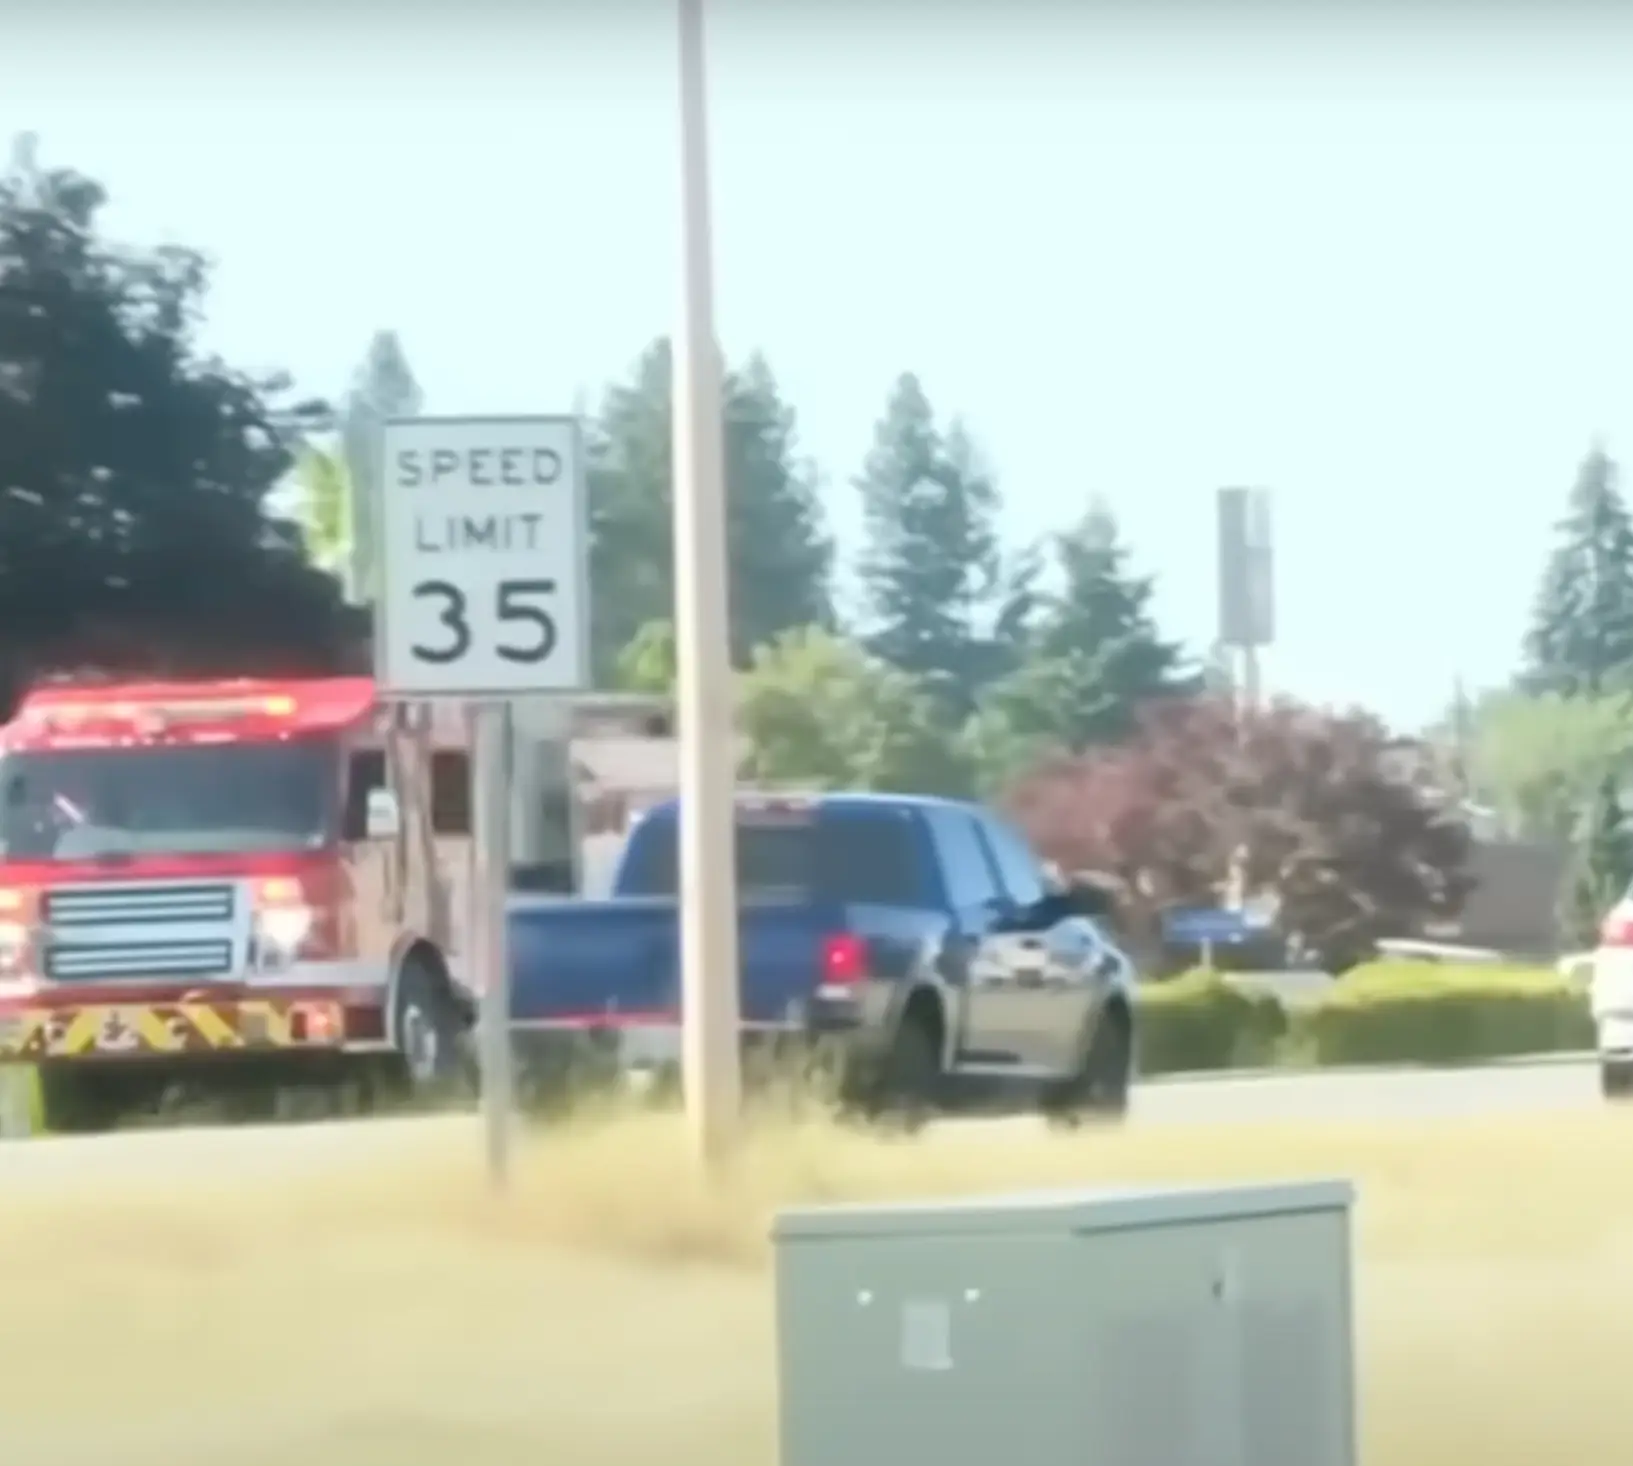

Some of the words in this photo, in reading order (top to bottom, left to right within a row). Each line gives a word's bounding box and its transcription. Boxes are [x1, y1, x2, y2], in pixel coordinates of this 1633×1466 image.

[396, 448, 563, 487] SPEED
[414, 512, 544, 553] LIMIT
[410, 578, 558, 664] 35
